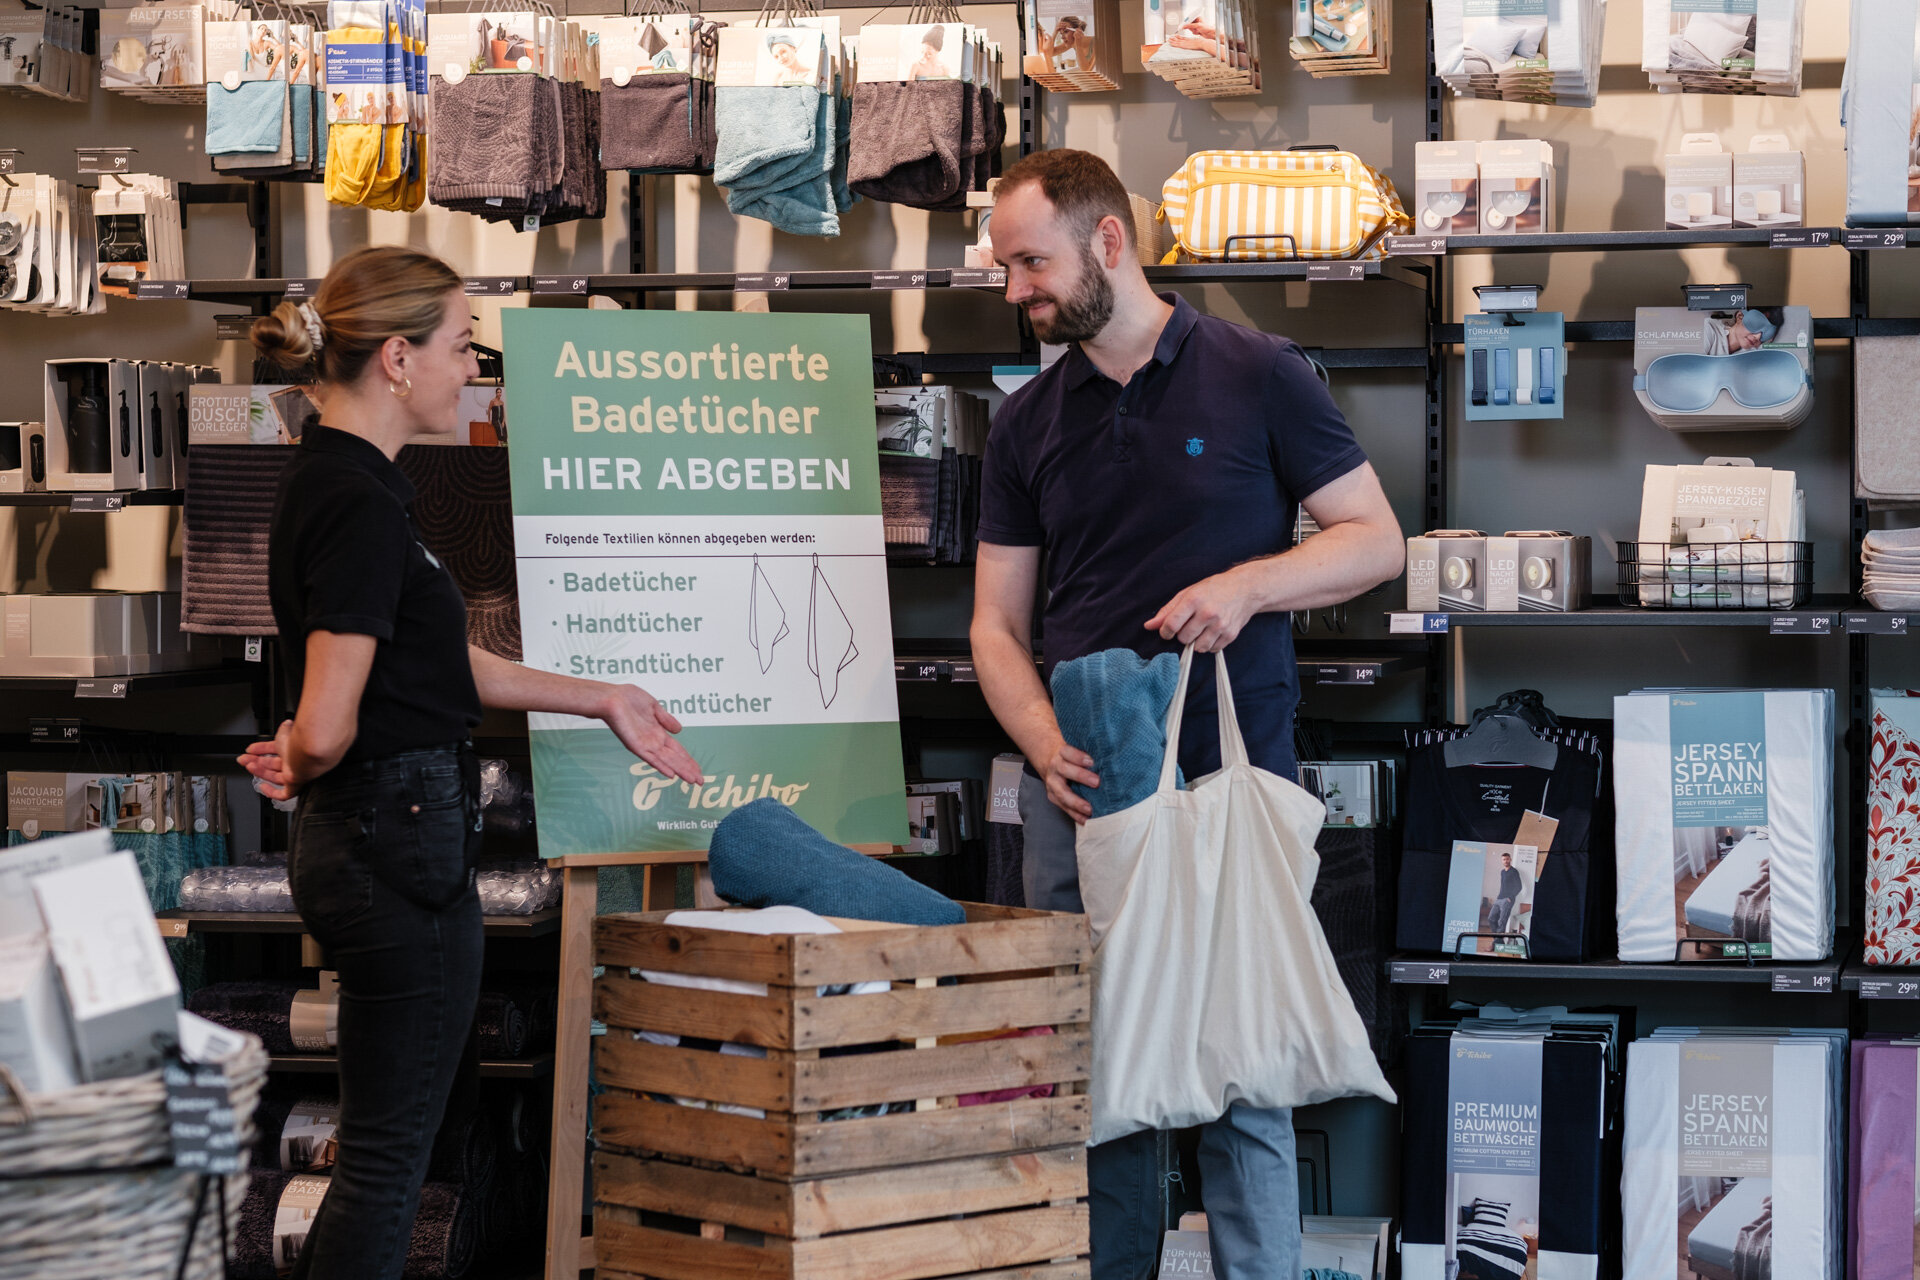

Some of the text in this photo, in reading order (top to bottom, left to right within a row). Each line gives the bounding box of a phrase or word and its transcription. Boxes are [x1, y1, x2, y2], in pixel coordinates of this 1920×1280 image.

[130, 9, 199, 21] HALTERSETS
[1468, 327, 1510, 336] TÜRHAKEN
[1637, 331, 1701, 339] SCHLAFMASKE
[554, 341, 829, 381] Aussortierte
[191, 397, 249, 408] FROTTIER
[191, 407, 248, 422] DUSCH
[571, 395, 820, 434] Badetücher
[191, 422, 248, 432] VORLEGER
[543, 457, 851, 490] HIER ABGEBEN
[1678, 485, 1767, 497] JERSEY-KISSEN
[1677, 494, 1766, 507] SPANNBEZÜGE
[545, 532, 816, 546] Folgende Textilien können abgegeben werden:
[1411, 560, 1436, 570] LED
[1490, 560, 1515, 570] LED
[564, 571, 697, 593] Badetücher
[566, 611, 703, 634] Handtücher
[569, 652, 724, 675] Strandtücher
[657, 693, 772, 714] andtücher
[1674, 742, 1762, 762] JERSEY
[1675, 761, 1764, 783] SPANN
[10, 786, 64, 797] JACQUARD
[680, 773, 810, 809] Tchibo
[1675, 782, 1764, 796] BETTLAKEN
[10, 796, 64, 806] HANDTÜCHER
[993, 797, 1017, 809] BAD
[657, 820, 720, 830] Wirklich Gut
[1448, 919, 1476, 928] JERSEY
[1683, 1094, 1768, 1112] JERSEY
[1454, 1102, 1538, 1119] PREMIUM
[1454, 1118, 1538, 1133] BAUMWOLL
[1683, 1112, 1768, 1134] SPANN
[1453, 1132, 1536, 1146] BETTWÄSCHE
[1683, 1133, 1768, 1147] BETTLAKEN
[287, 1186, 327, 1194] BADE
[1165, 1249, 1211, 1259] TÜR-HAN
[1162, 1258, 1212, 1273] HALT
